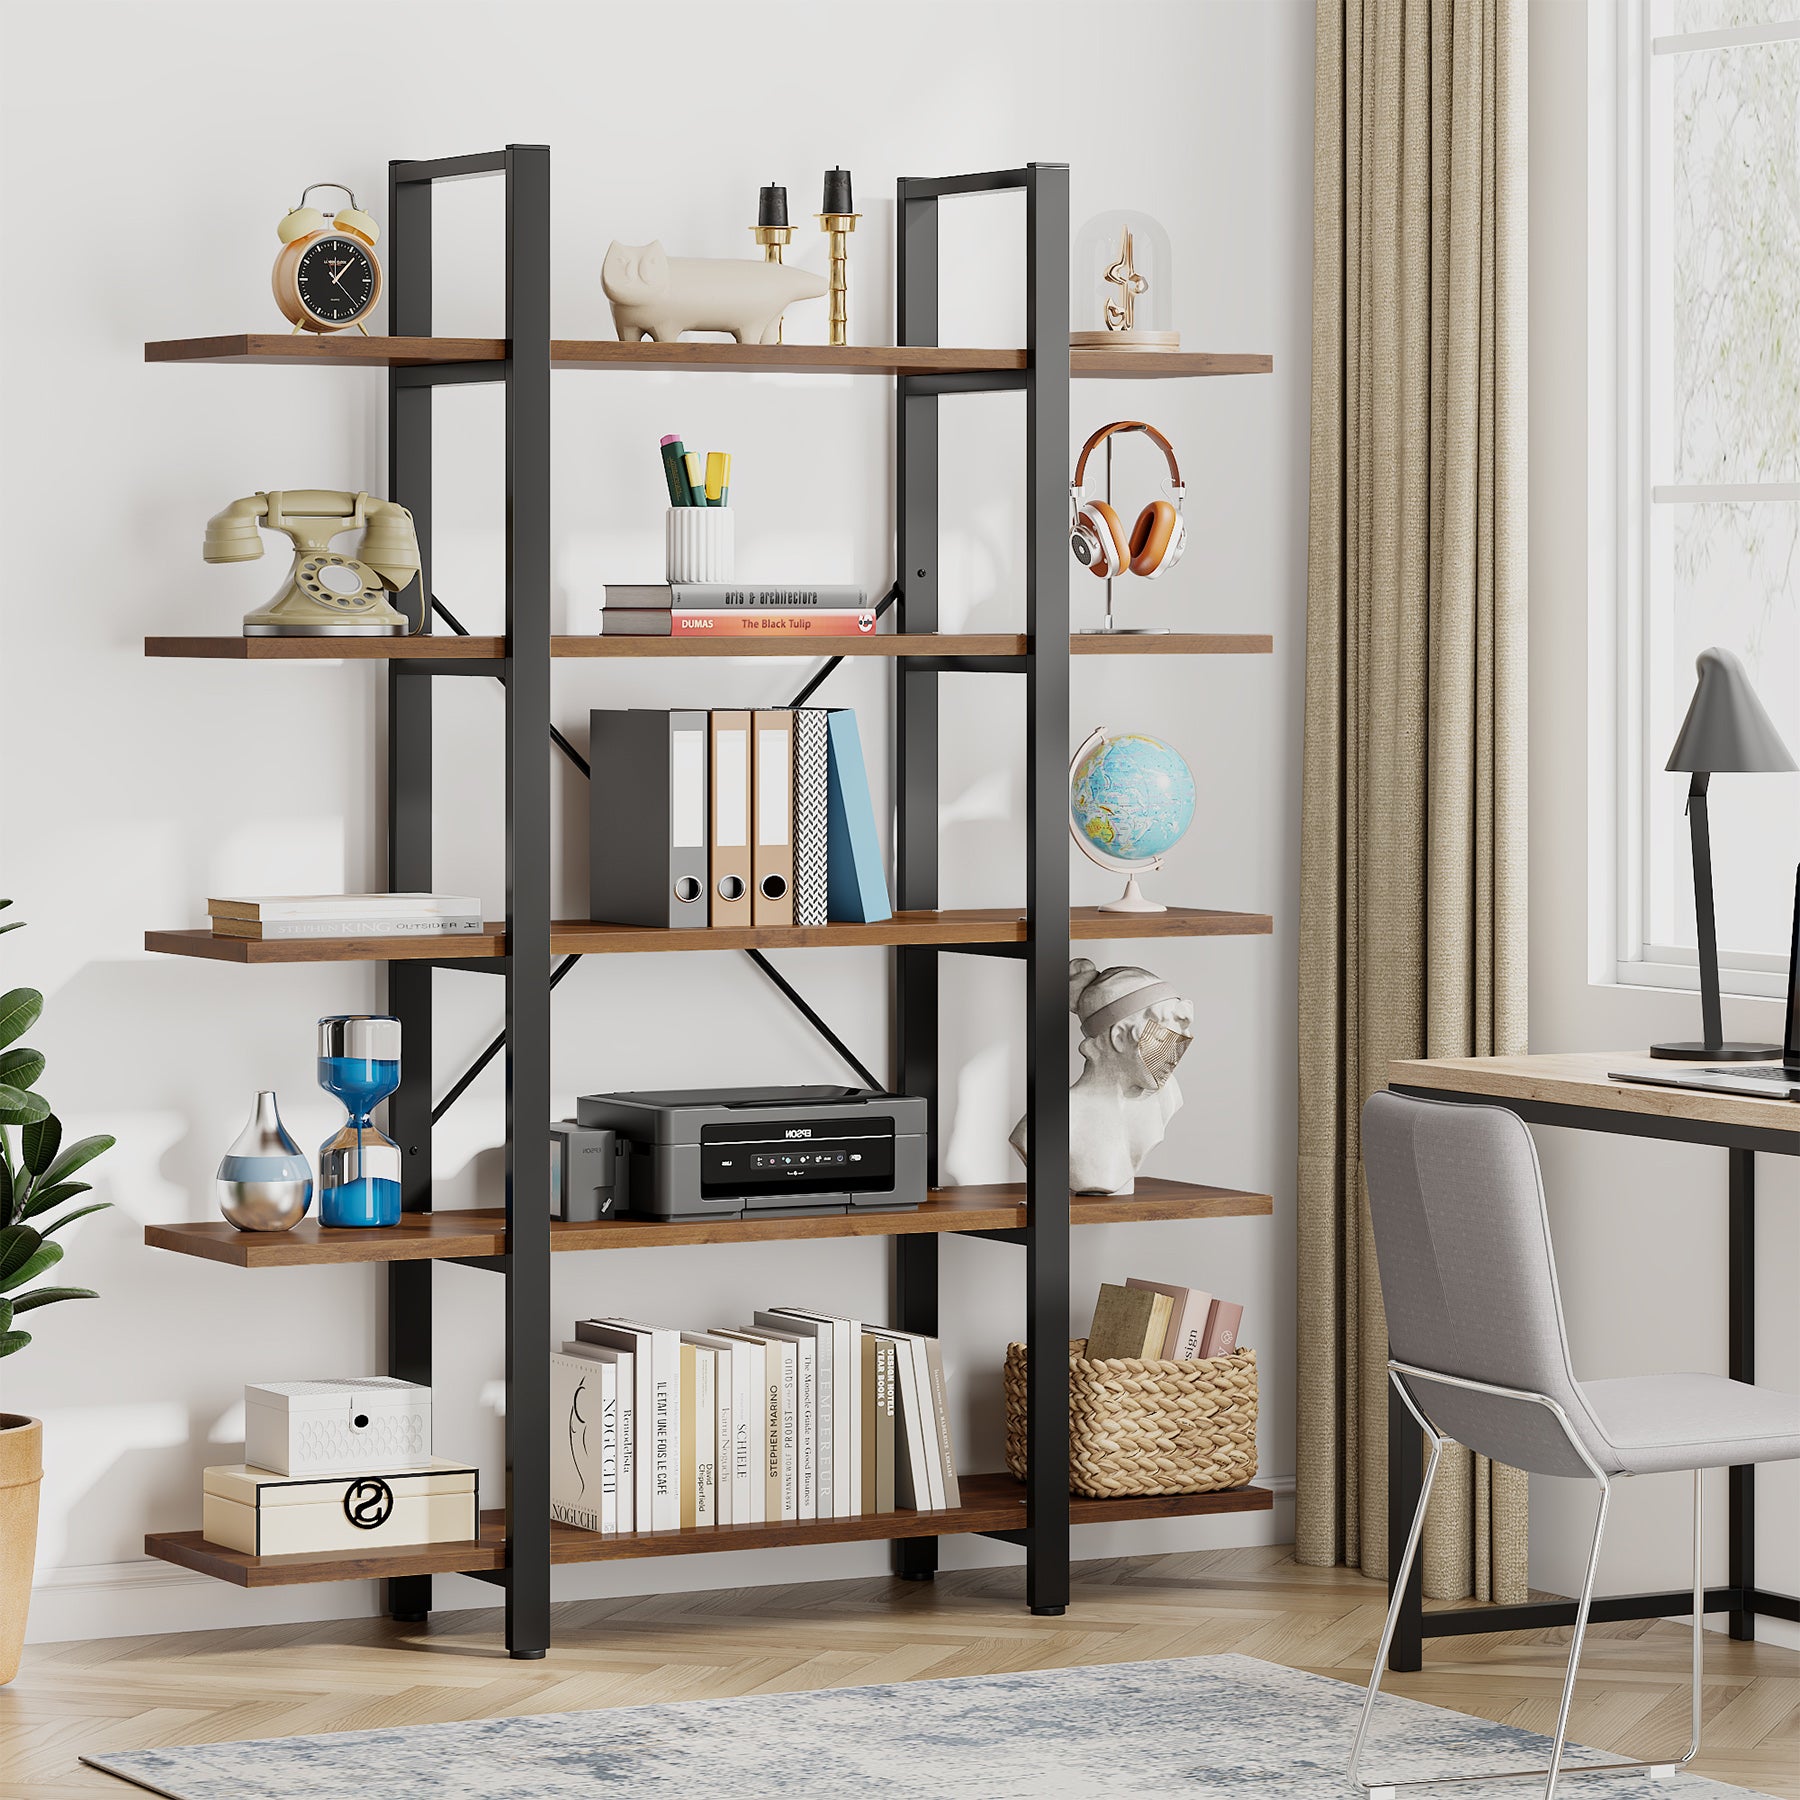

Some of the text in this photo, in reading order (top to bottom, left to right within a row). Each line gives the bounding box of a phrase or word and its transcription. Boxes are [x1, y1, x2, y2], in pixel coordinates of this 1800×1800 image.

[725, 591, 818, 605] arts & architecture
[681, 619, 714, 628] DUMAS
[742, 619, 811, 630] The Black Tulip
[342, 922, 390, 933] KING
[396, 922, 457, 930] OUTSIDER
[1184, 1329, 1198, 1362] sign
[784, 1358, 792, 1388] SQUID
[804, 1355, 812, 1371] The
[804, 1374, 812, 1408] Monocle
[657, 1419, 667, 1436] UNE
[769, 1385, 778, 1478] STEPHEN MARINO
[784, 1410, 792, 1448] PROUST
[804, 1410, 812, 1434] Guide
[820, 1368, 830, 1496] LEMPEREUR
[603, 1398, 616, 1494] NOGUCHI
[623, 1410, 632, 1474] Remodelista
[657, 1440, 667, 1458] FOIS
[736, 1424, 747, 1479] SCHIELE
[657, 1461, 667, 1470] LE
[720, 1440, 730, 1482] Noguchi
[804, 1447, 812, 1470] Good
[698, 1464, 706, 1512] Chipperfield
[804, 1472, 812, 1506] Business
[552, 1504, 598, 1531] NOGUCHI
